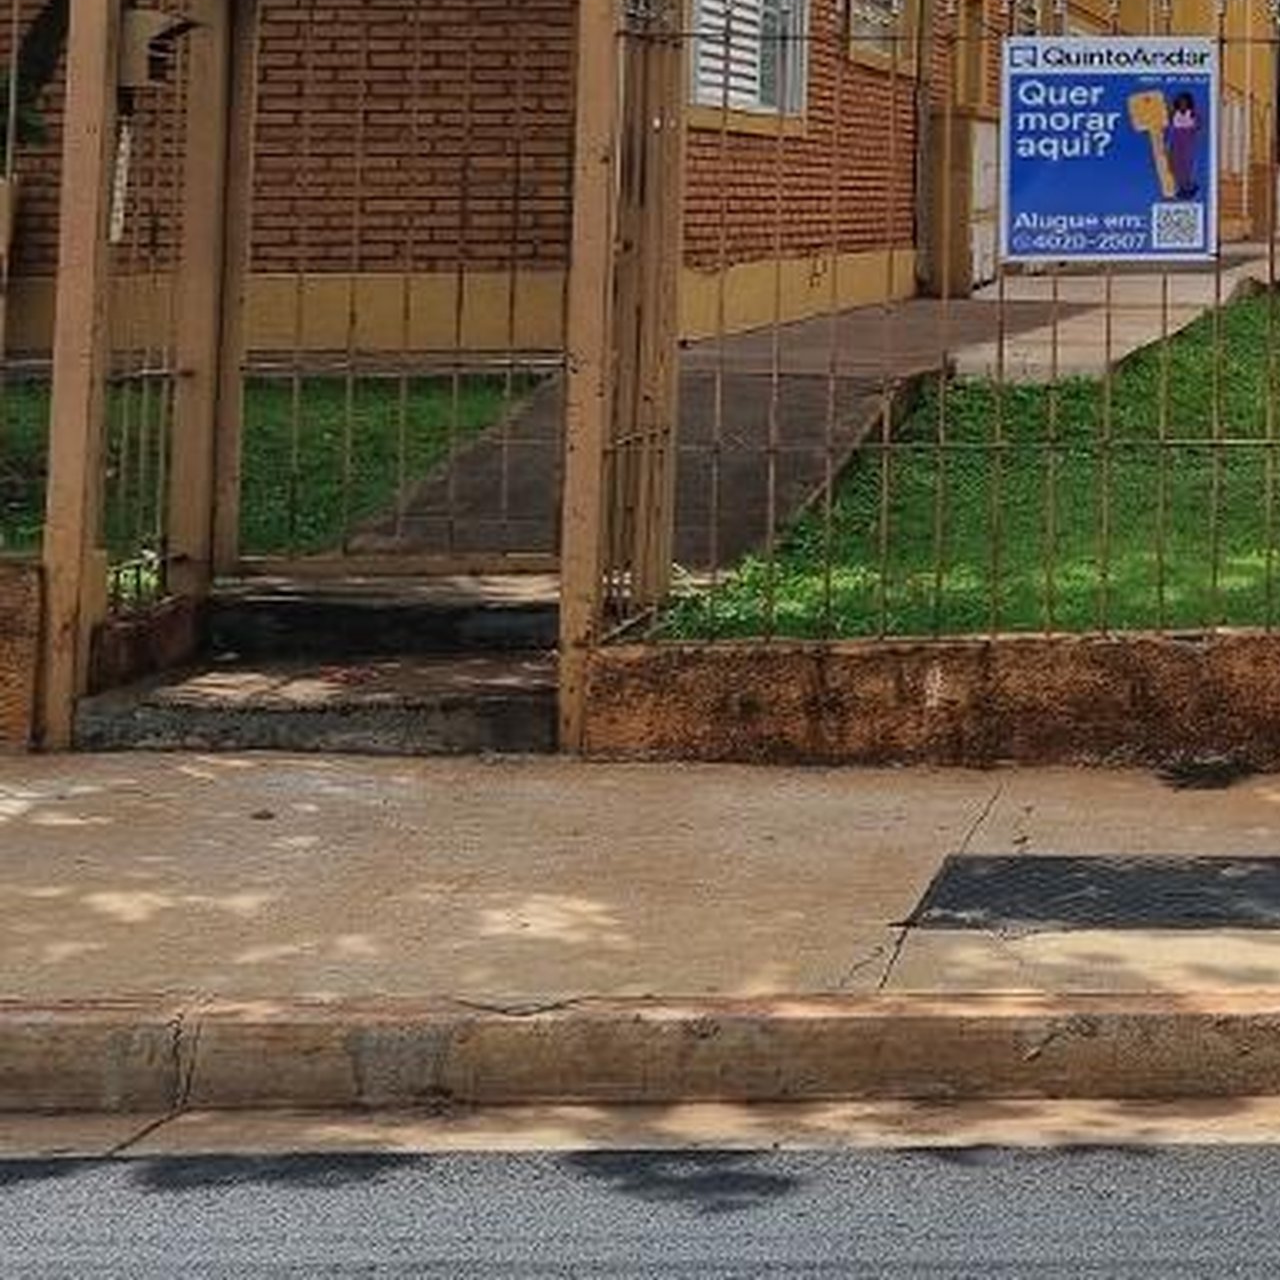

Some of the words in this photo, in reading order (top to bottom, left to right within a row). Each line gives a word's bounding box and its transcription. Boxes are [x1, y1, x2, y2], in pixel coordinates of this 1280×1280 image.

[1042, 47, 1210, 67] QuintoAndar
[1018, 80, 1104, 106] Quer
[1017, 111, 1121, 132] morar
[1016, 132, 1112, 161] aqui?
[1014, 212, 1099, 234] Alugue
